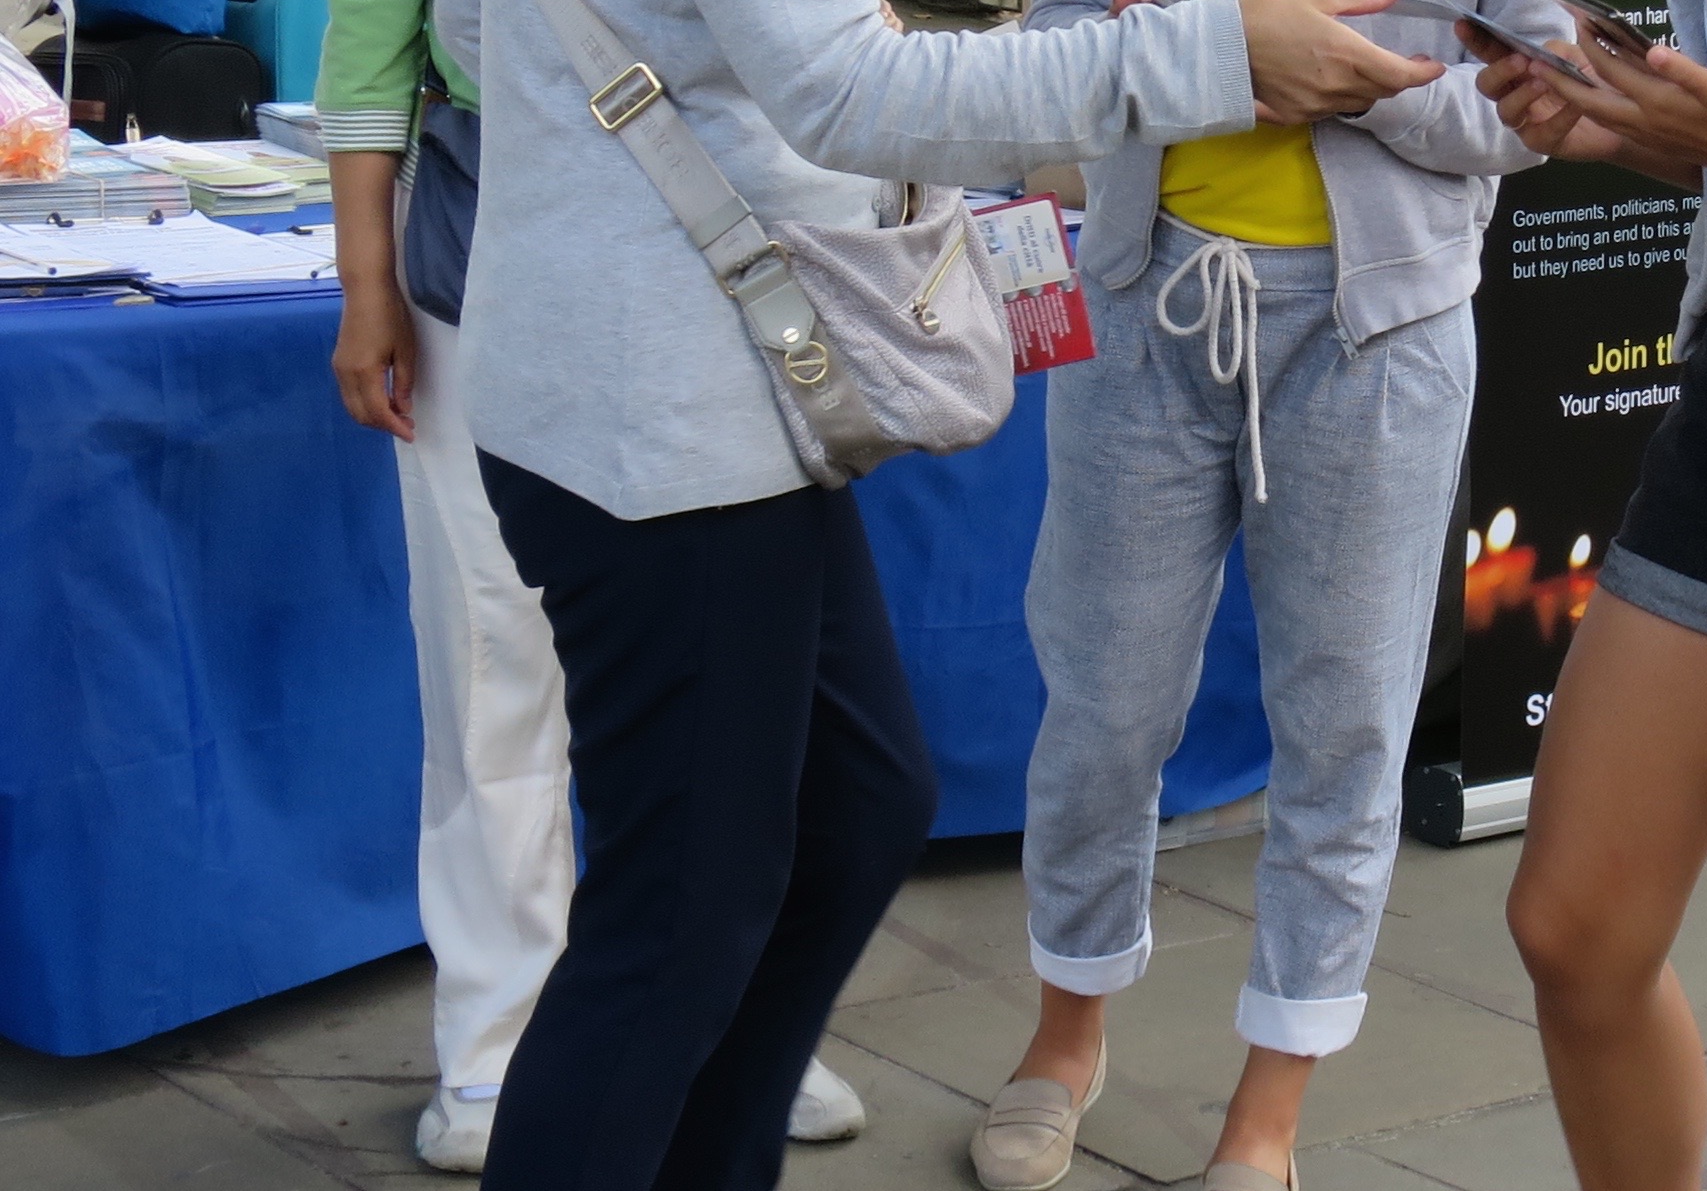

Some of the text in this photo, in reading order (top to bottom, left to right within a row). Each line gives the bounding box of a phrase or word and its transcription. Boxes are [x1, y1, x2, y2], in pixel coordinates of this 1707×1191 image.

[1513, 205, 1608, 228] Governments,
[1612, 197, 1679, 221] politicians,
[1513, 238, 1536, 253] out
[1540, 236, 1553, 250] to
[1557, 232, 1589, 251] bring
[1594, 231, 1609, 245] an
[1614, 225, 1638, 243] end
[1642, 223, 1654, 238] to
[1658, 220, 1679, 238] this
[1513, 262, 1536, 279] but
[1540, 257, 1568, 278] they
[1573, 254, 1604, 273] need
[1609, 253, 1625, 268] us
[1628, 250, 1640, 266] to
[1644, 247, 1670, 269] give
[1588, 339, 1647, 375] Join
[1559, 393, 1600, 417] Your
